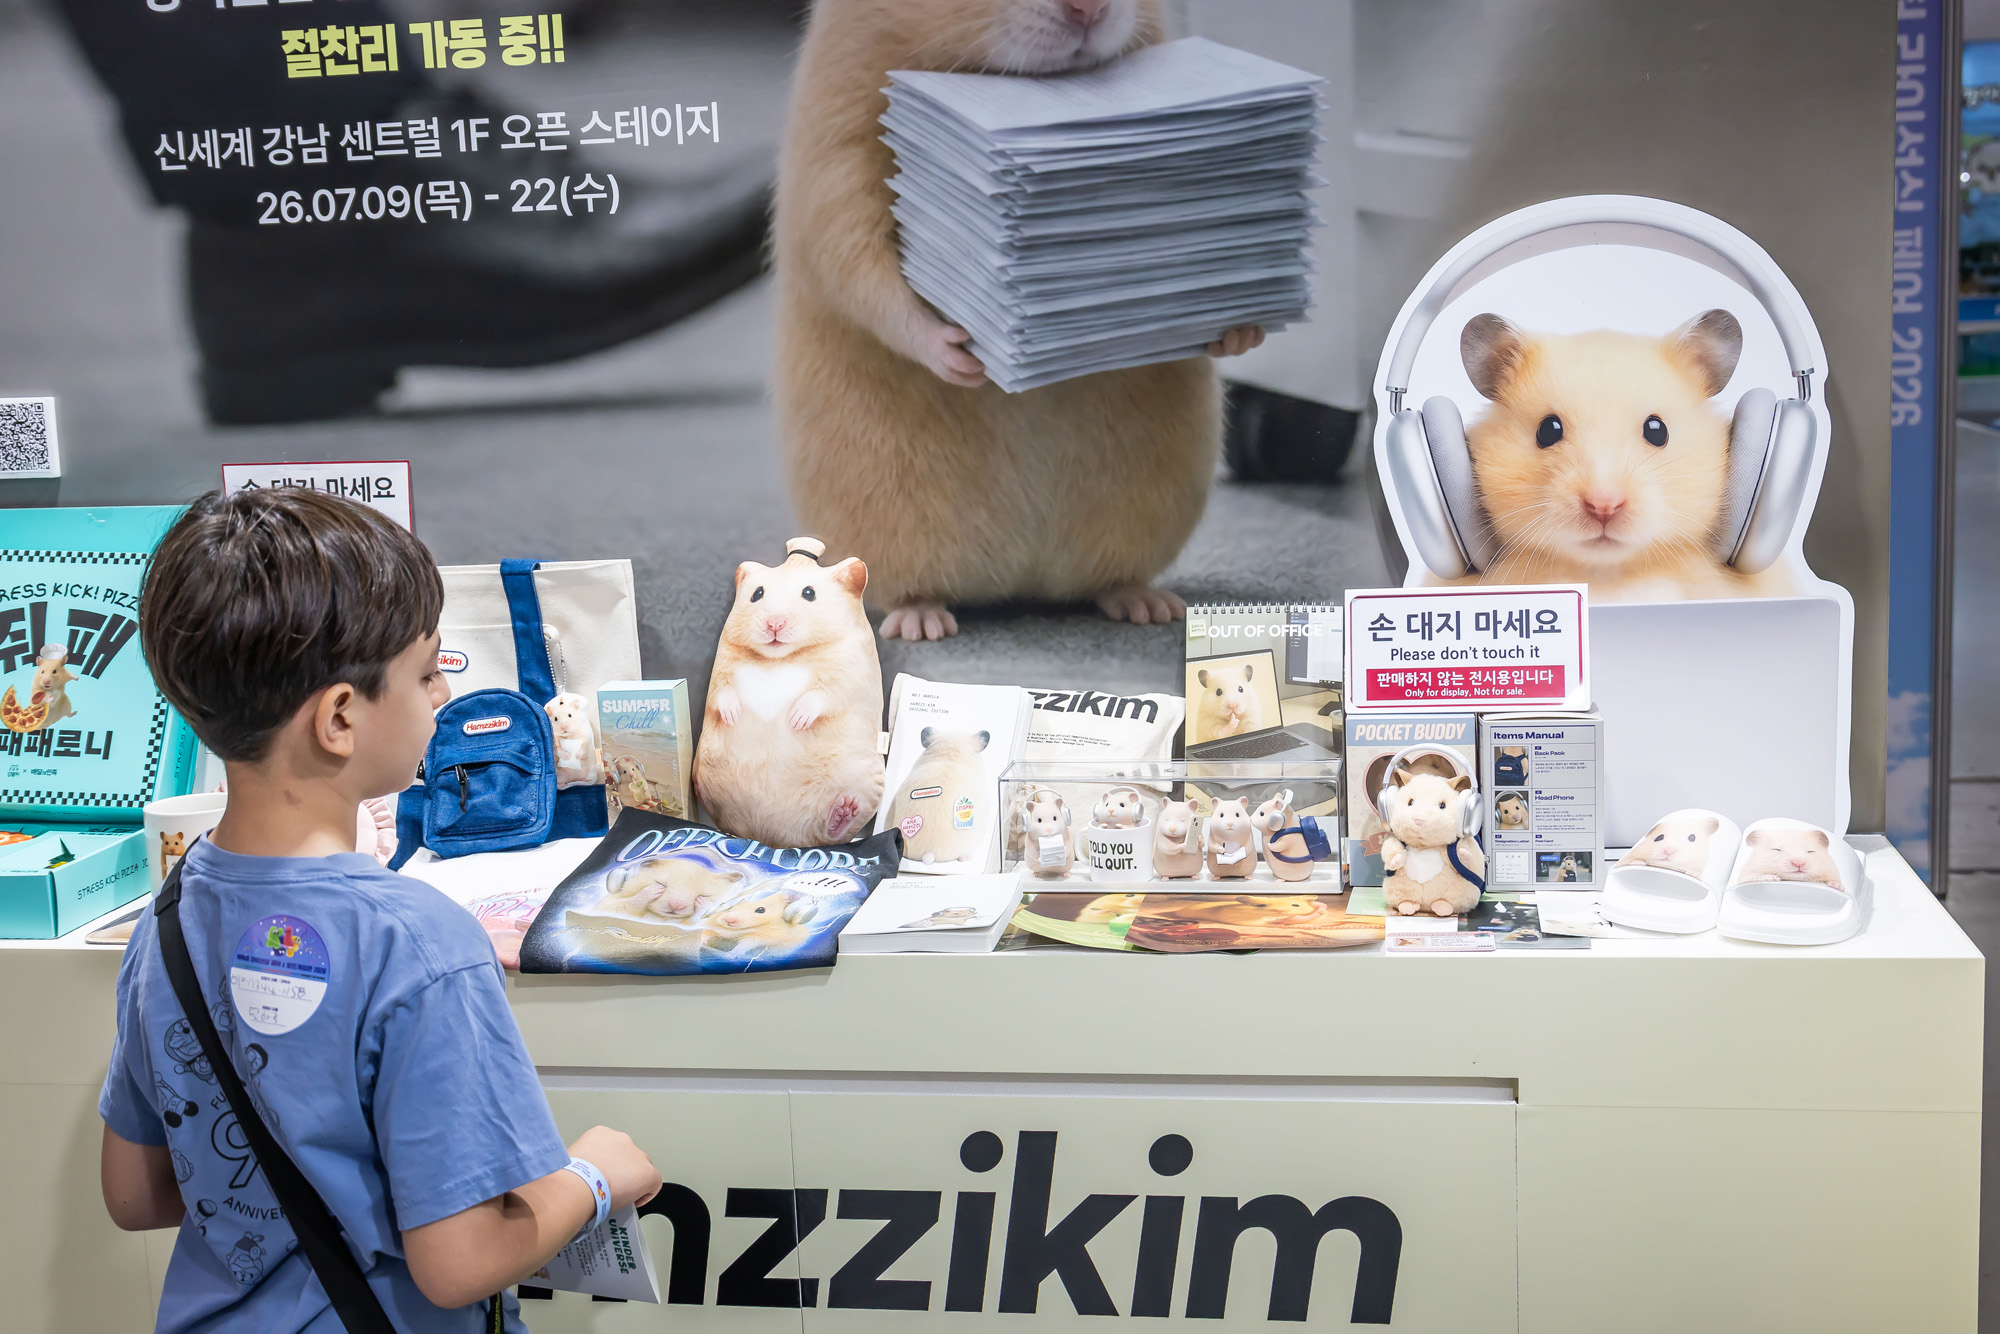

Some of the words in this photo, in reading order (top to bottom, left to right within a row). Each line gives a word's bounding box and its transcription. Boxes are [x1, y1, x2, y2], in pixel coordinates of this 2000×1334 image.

[281, 23, 399, 79] 절찬리
[408, 18, 487, 70] 가동
[498, 13, 566, 67] 중!!
[153, 127, 255, 172] 신세계
[262, 123, 331, 166] 강남
[339, 116, 442, 161] 센트럴
[450, 117, 490, 152] 1F
[500, 111, 571, 151] 오픈
[579, 101, 720, 147] 스테이지
[256, 180, 473, 225] 26.07.09(목)
[509, 173, 620, 217] 22(수)
[1893, 226, 1924, 314] 페어
[1891, 327, 1924, 426] 2026
[52, 582, 100, 600] KICK!
[1207, 624, 1241, 639] OUT
[1244, 624, 1266, 639] OF
[1268, 623, 1323, 639] OFFICE
[1367, 612, 1397, 642] 손
[1406, 610, 1461, 641] 대지
[1474, 608, 1562, 640] 마세요
[1390, 647, 1436, 661] Please
[1440, 646, 1478, 660] don't
[1482, 645, 1525, 659] touch
[1530, 645, 1540, 658] it
[1376, 671, 1432, 688] 판매하지
[1436, 671, 1465, 686] 않는
[1468, 669, 1554, 686] 전시용입니다
[1405, 688, 1424, 698] Only
[1426, 688, 1439, 697] for
[1440, 687, 1472, 698] display,
[1473, 687, 1490, 696] Not
[1491, 686, 1504, 696] for
[1506, 686, 1526, 696] sale.
[602, 699, 671, 713] SUMMER
[466, 719, 508, 732] Hamzzikim
[616, 706, 660, 730] Chill
[1354, 723, 1414, 741] POCKET
[1413, 722, 1467, 740] BUDDY
[1493, 731, 1524, 740] Items
[1525, 731, 1564, 740] Manual
[1089, 840, 1108, 855] TOLD
[1109, 843, 1133, 855] YOU
[1105, 857, 1138, 871] QUIT.
[77, 879, 105, 900] STRESS
[121, 862, 139, 880] PIZZA
[222, 1196, 286, 1220] ANNIVE
[518, 1130, 1404, 1326] zzikim
